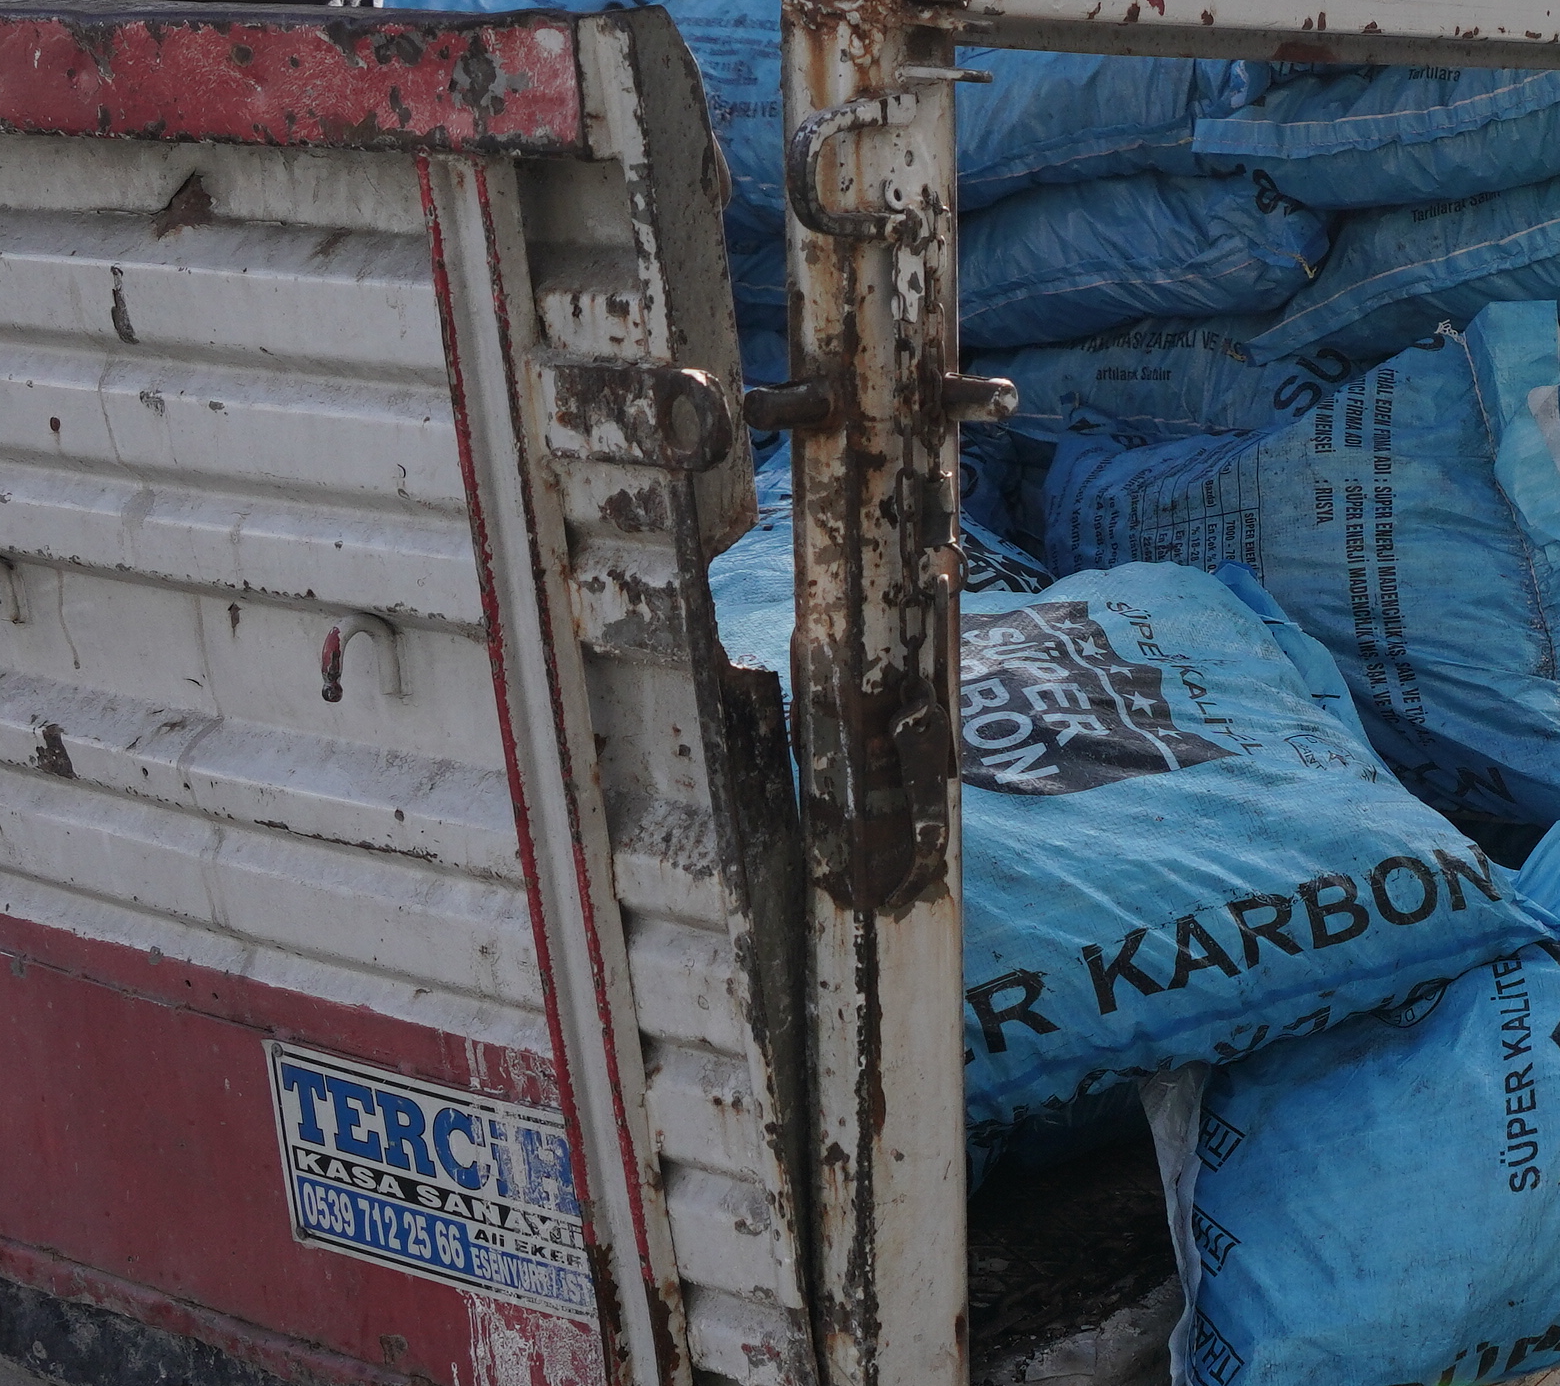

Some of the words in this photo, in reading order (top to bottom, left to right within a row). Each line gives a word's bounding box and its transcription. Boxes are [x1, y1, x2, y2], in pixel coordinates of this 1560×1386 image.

[1344, 397, 1369, 431] FİRMA
[1374, 398, 1394, 426] EDEN
[1310, 413, 1339, 455] MENŞEİ
[1344, 432, 1364, 448] ADI
[1374, 455, 1390, 475] ADI
[1315, 486, 1335, 525] RUSYA
[1344, 485, 1368, 521] SÜPER
[1373, 485, 1398, 519] SÜPER
[1225, 520, 1236, 541] 7000
[1244, 512, 1256, 539] SÜPER
[1345, 523, 1370, 563] ENERJİ
[1374, 522, 1400, 562] ENERJİ
[1348, 566, 1377, 638] MADENCİLİK
[1378, 565, 1405, 638] MADENCİLİK
[964, 626, 1111, 749] SÜPER
[1403, 687, 1420, 705] VE
[1081, 843, 1502, 1016] KARBON
[1500, 1062, 1541, 1192] SÜPER
[294, 1151, 413, 1198] KASA
[302, 1181, 356, 1238] 0539
[358, 1196, 402, 1251] 712
[402, 1212, 432, 1260] 25
[434, 1223, 466, 1270] 66
[474, 1229, 505, 1248] Ali
